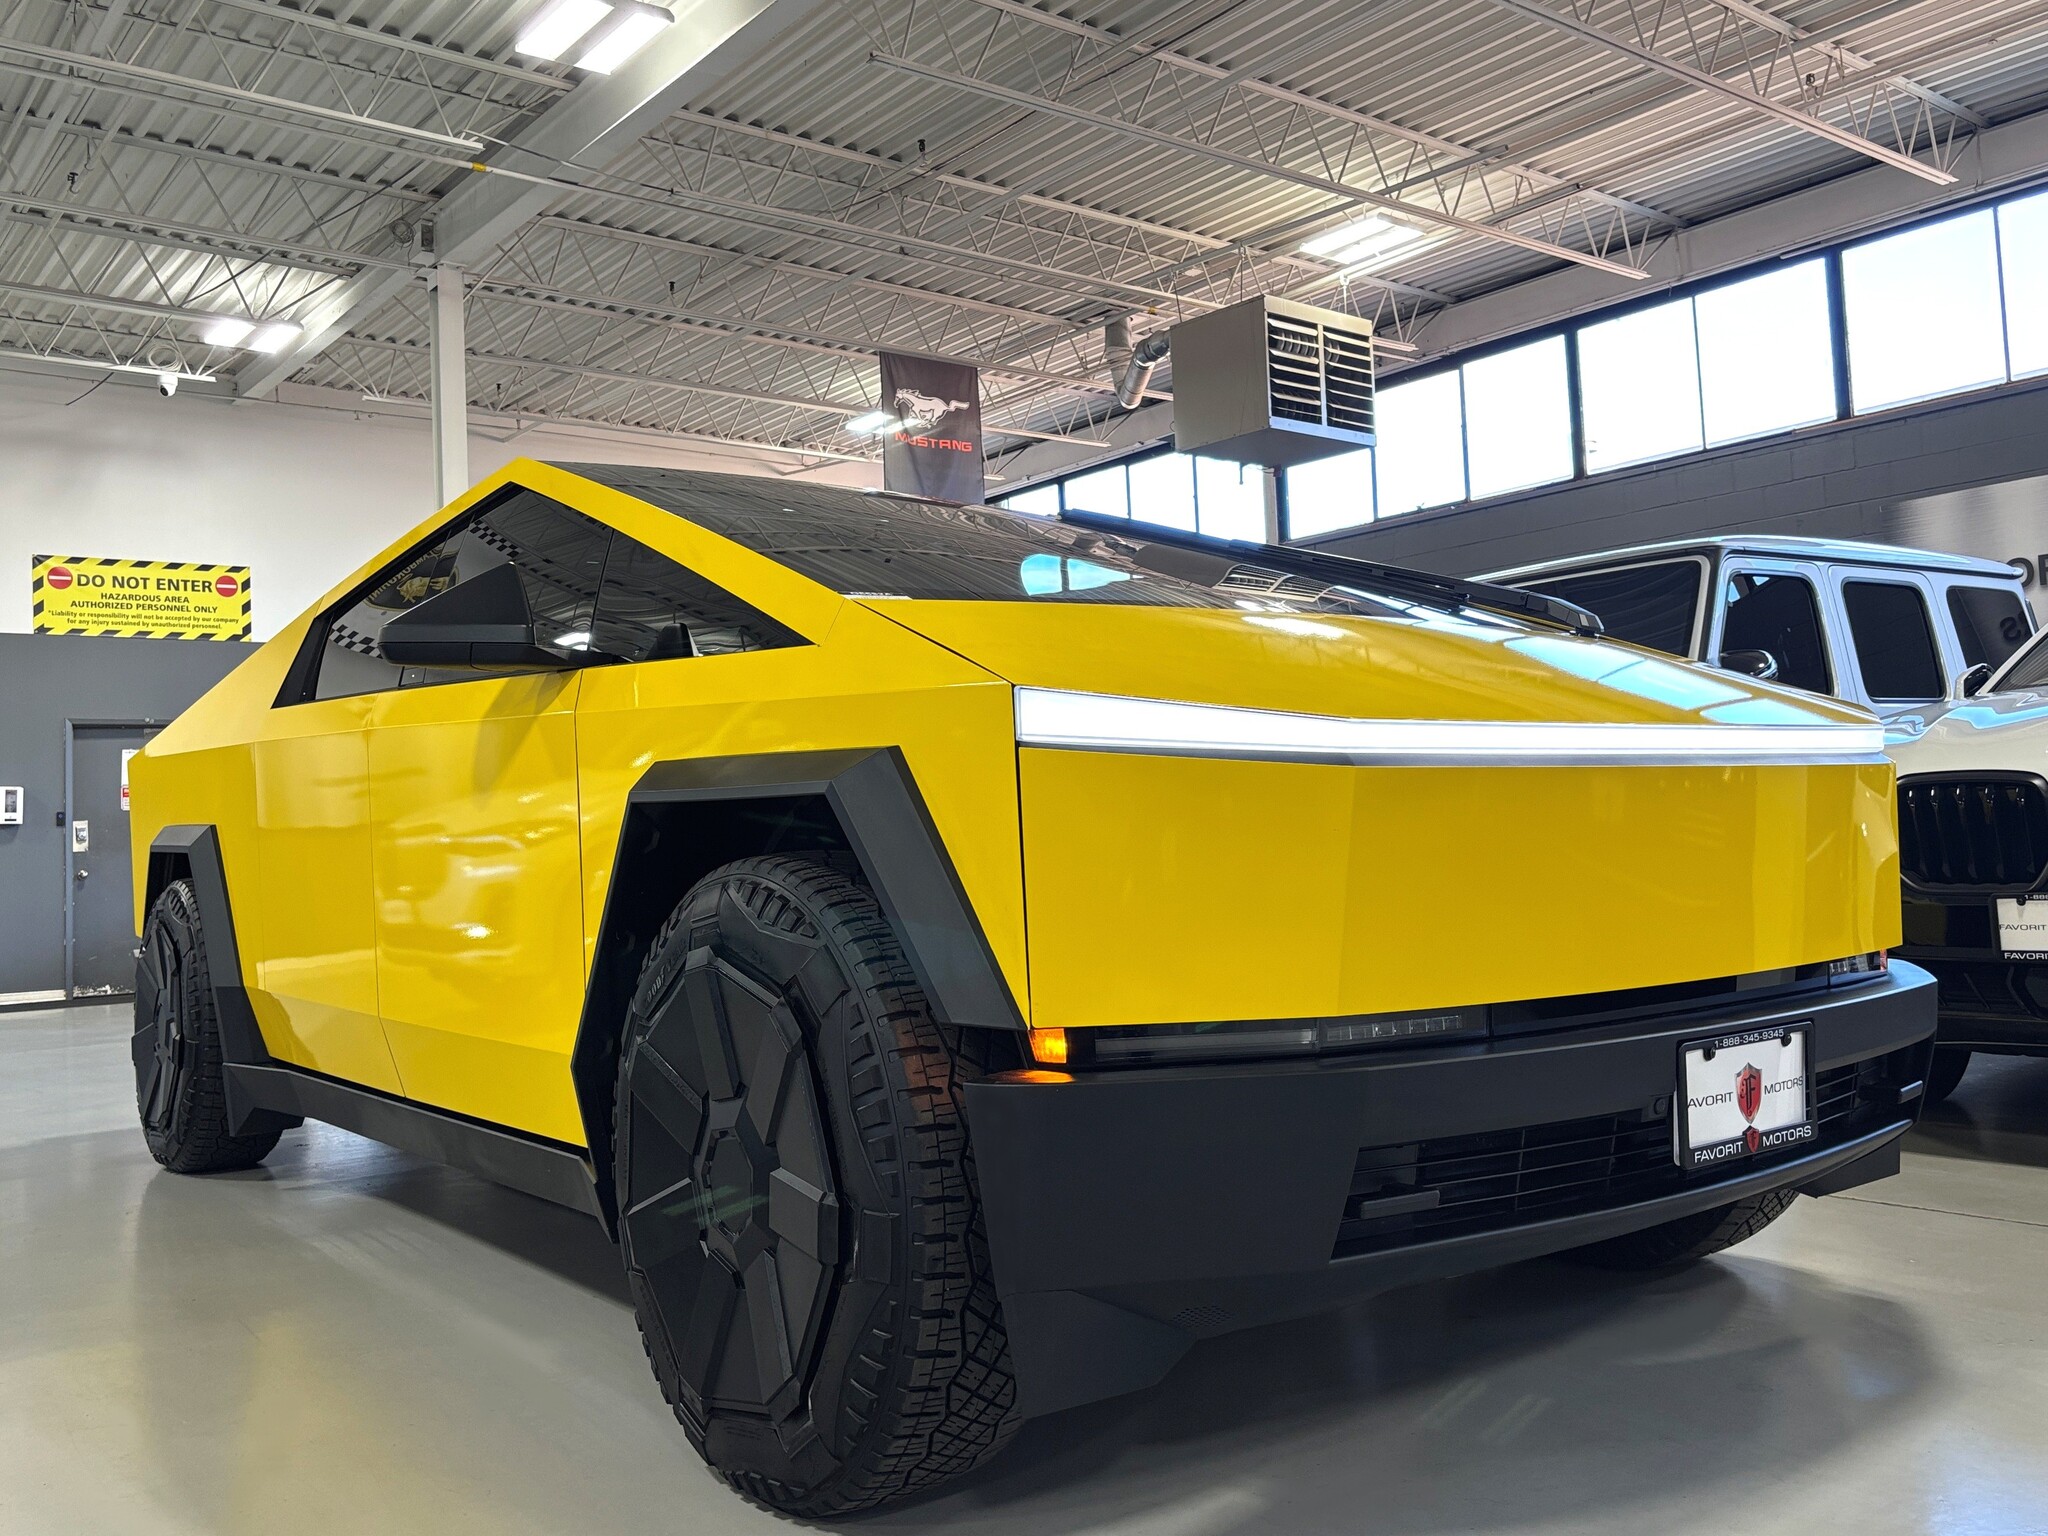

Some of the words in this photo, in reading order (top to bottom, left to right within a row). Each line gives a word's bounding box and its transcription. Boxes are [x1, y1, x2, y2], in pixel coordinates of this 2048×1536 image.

[895, 431, 973, 452] MUSTANG
[77, 574, 106, 588] DO
[112, 575, 151, 590] NOT
[156, 578, 213, 593] ENTER
[100, 592, 161, 602] HAZARDOUS
[164, 595, 190, 604] AREA
[70, 600, 133, 610] AUTHORIZED
[135, 604, 191, 613] PERSONNEL
[193, 606, 218, 614] ONLY
[87, 612, 130, 620] responsibility
[164, 615, 192, 623] accepted
[193, 615, 200, 623] by
[213, 617, 239, 625] company
[91, 618, 110, 626] injury
[1999, 923, 2047, 931] FAVORIT
[1714, 1028, 1785, 1048] 1-888-345-9345
[1687, 1091, 1734, 1109] AVORIT
[1764, 1076, 1804, 1095] MOTORS
[1694, 1141, 1743, 1163] FAVORIT
[1762, 1125, 1812, 1147] MOTORS
